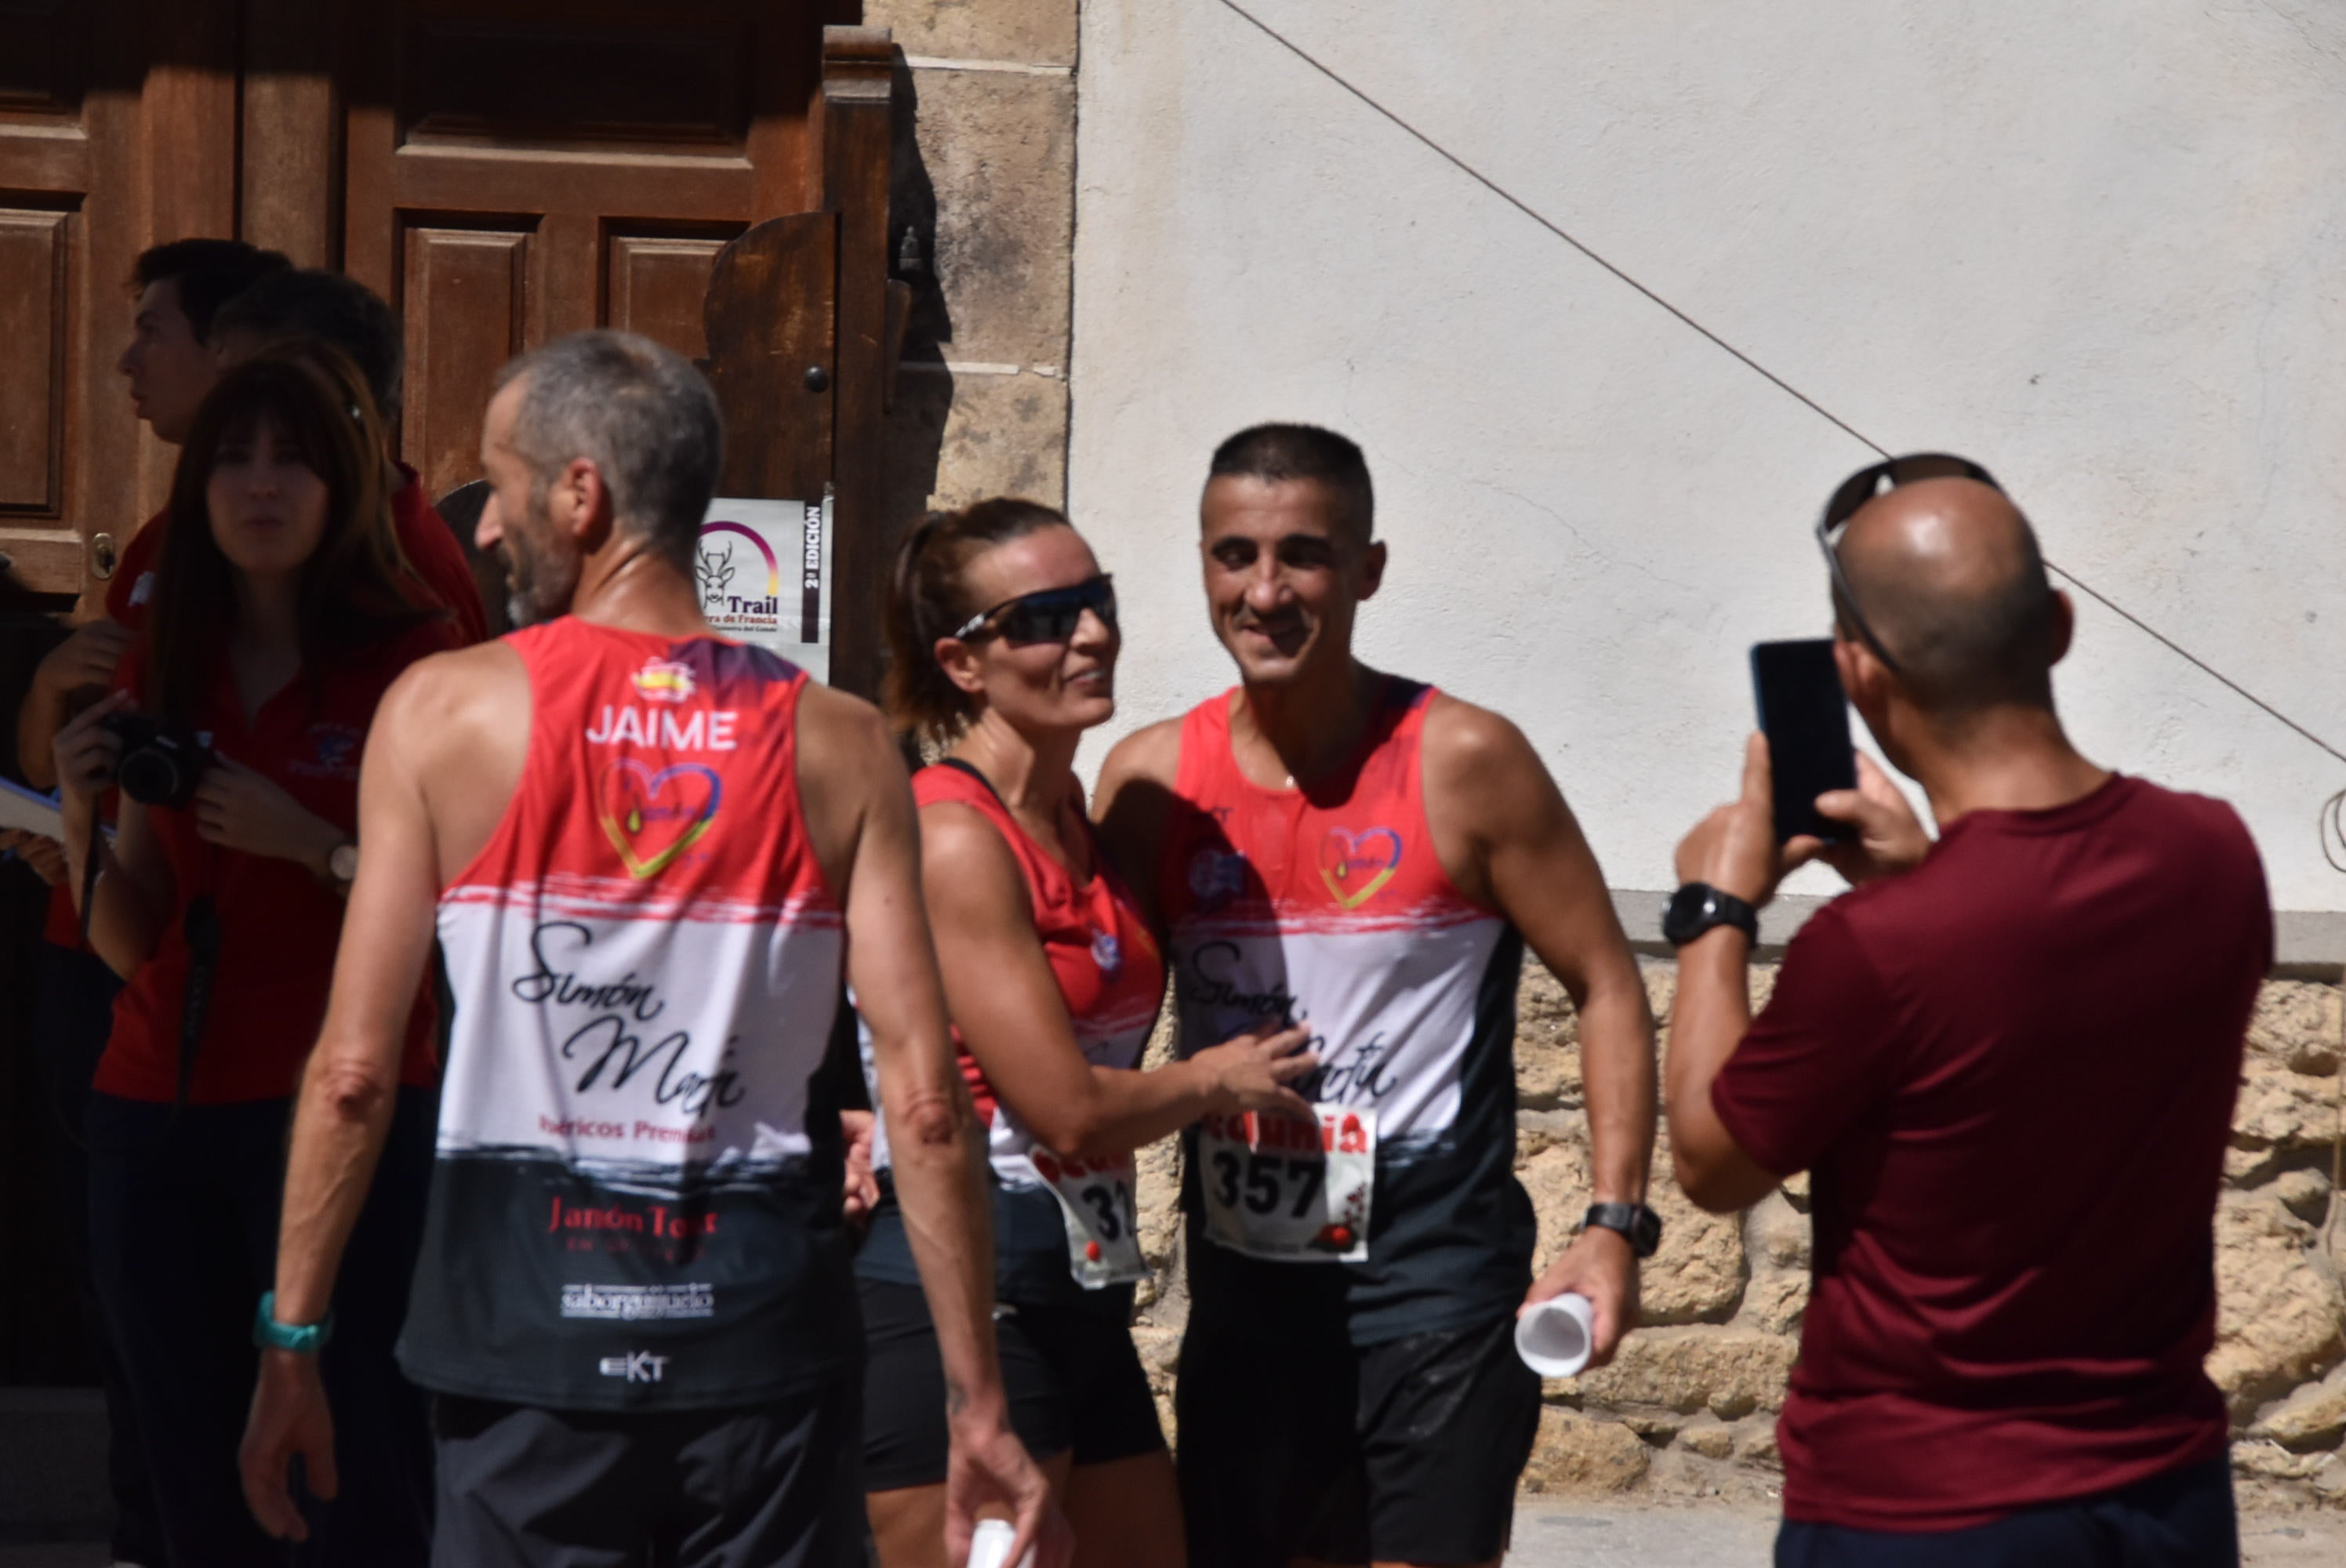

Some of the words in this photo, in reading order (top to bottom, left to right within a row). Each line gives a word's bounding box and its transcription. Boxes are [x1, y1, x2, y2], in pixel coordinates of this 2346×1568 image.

[803, 506, 821, 570] EDICIÓN
[727, 595, 778, 614] Trail
[739, 614, 777, 624] Francia
[586, 705, 738, 750] JAIME
[513, 920, 665, 1021] Simón
[1212, 1150, 1326, 1219] 357
